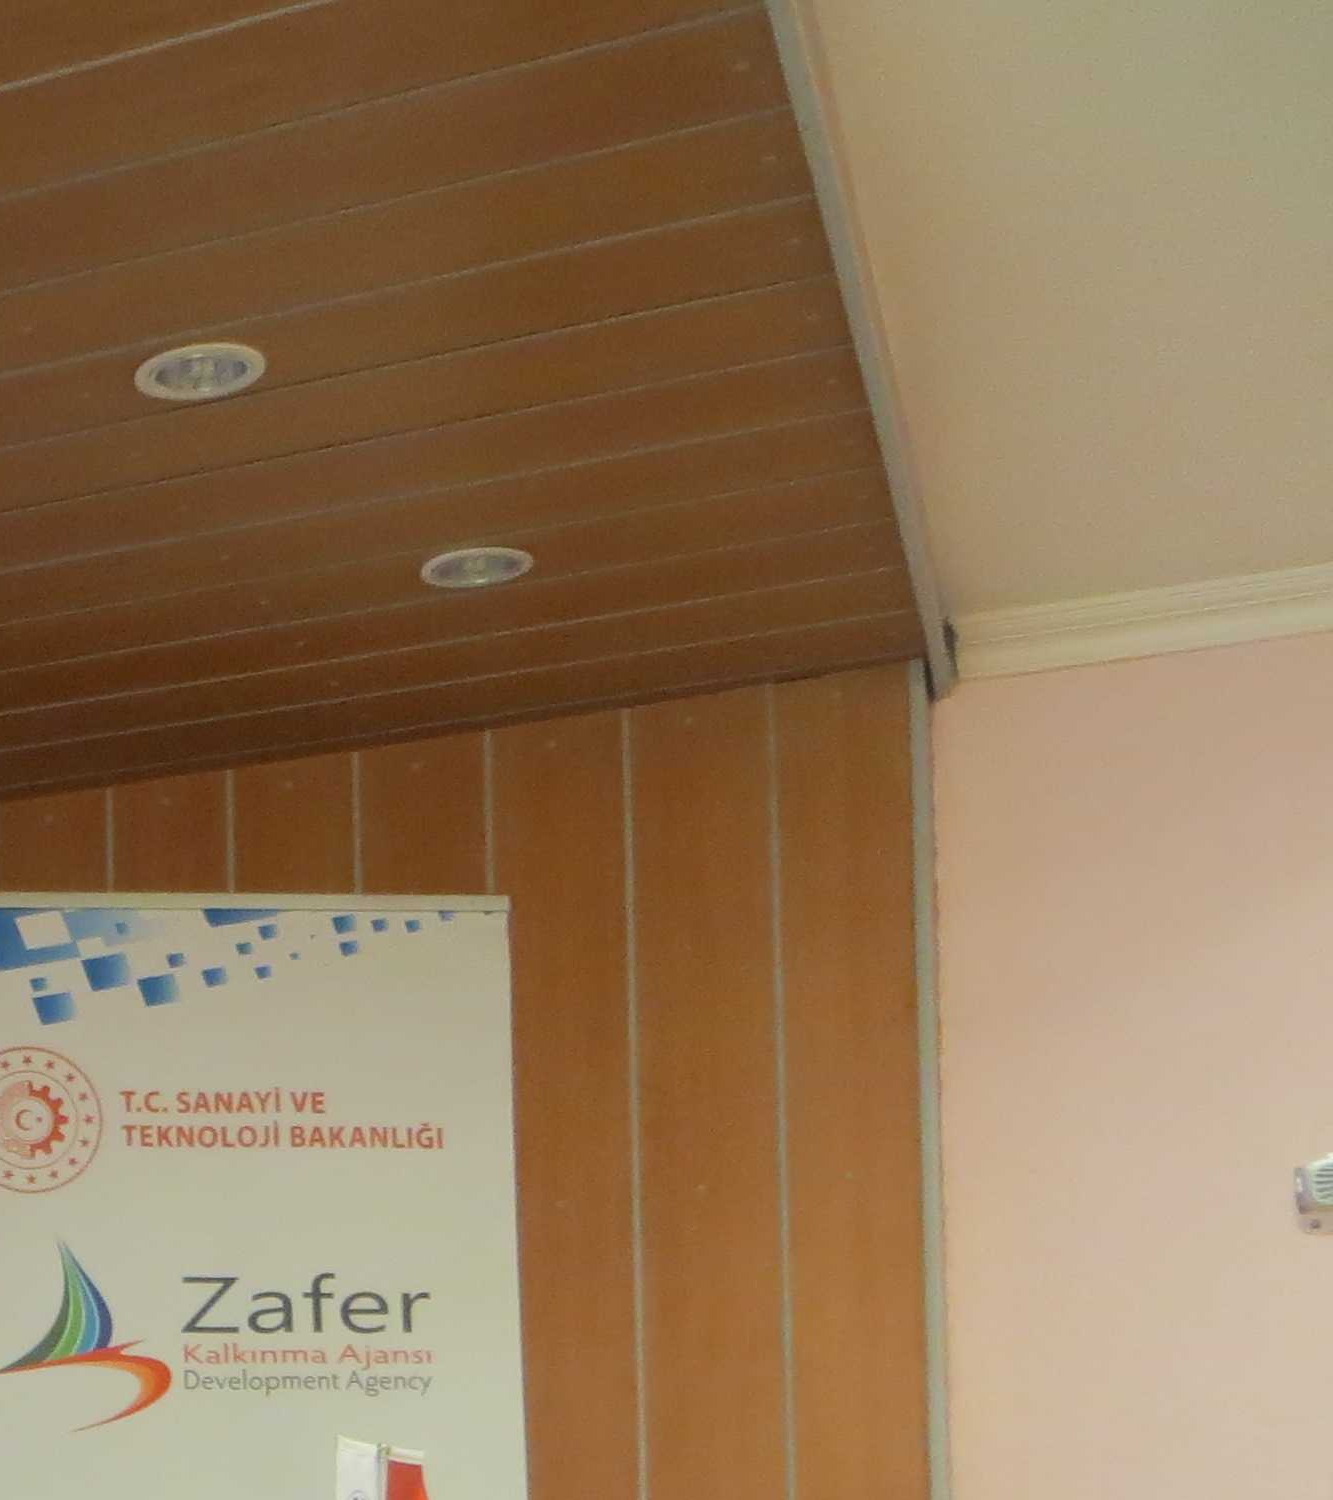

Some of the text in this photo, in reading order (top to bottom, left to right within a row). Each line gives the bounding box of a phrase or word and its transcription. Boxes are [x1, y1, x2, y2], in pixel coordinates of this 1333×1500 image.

[119, 1086, 326, 1114] T.C. SANAYİ VE
[121, 1121, 445, 1150] TEKNOLOJİ BAKANLIĞI
[180, 1272, 432, 1334] Zafer
[183, 1342, 434, 1371] Kalkınma Ajansı
[183, 1368, 433, 1397] Development Agency
